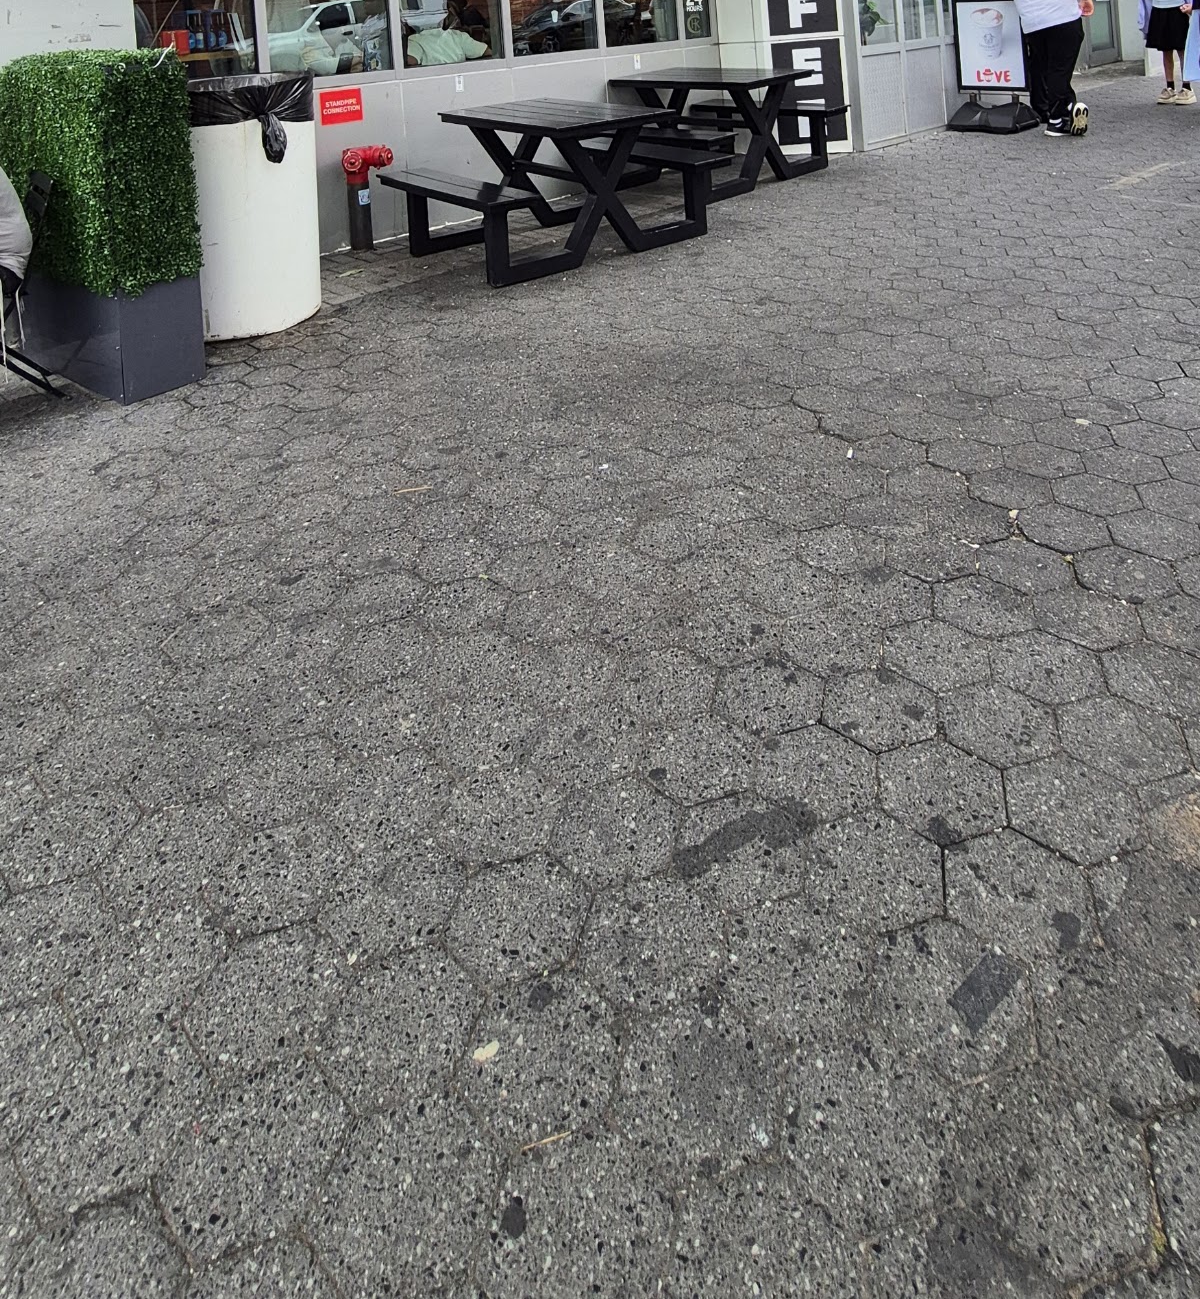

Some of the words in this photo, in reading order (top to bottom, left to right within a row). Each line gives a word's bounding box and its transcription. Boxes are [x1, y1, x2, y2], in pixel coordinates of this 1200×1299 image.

[686, 4, 704, 12] HOURS
[325, 97, 357, 108] STANDPIPE
[322, 104, 361, 115] CONNECTION
